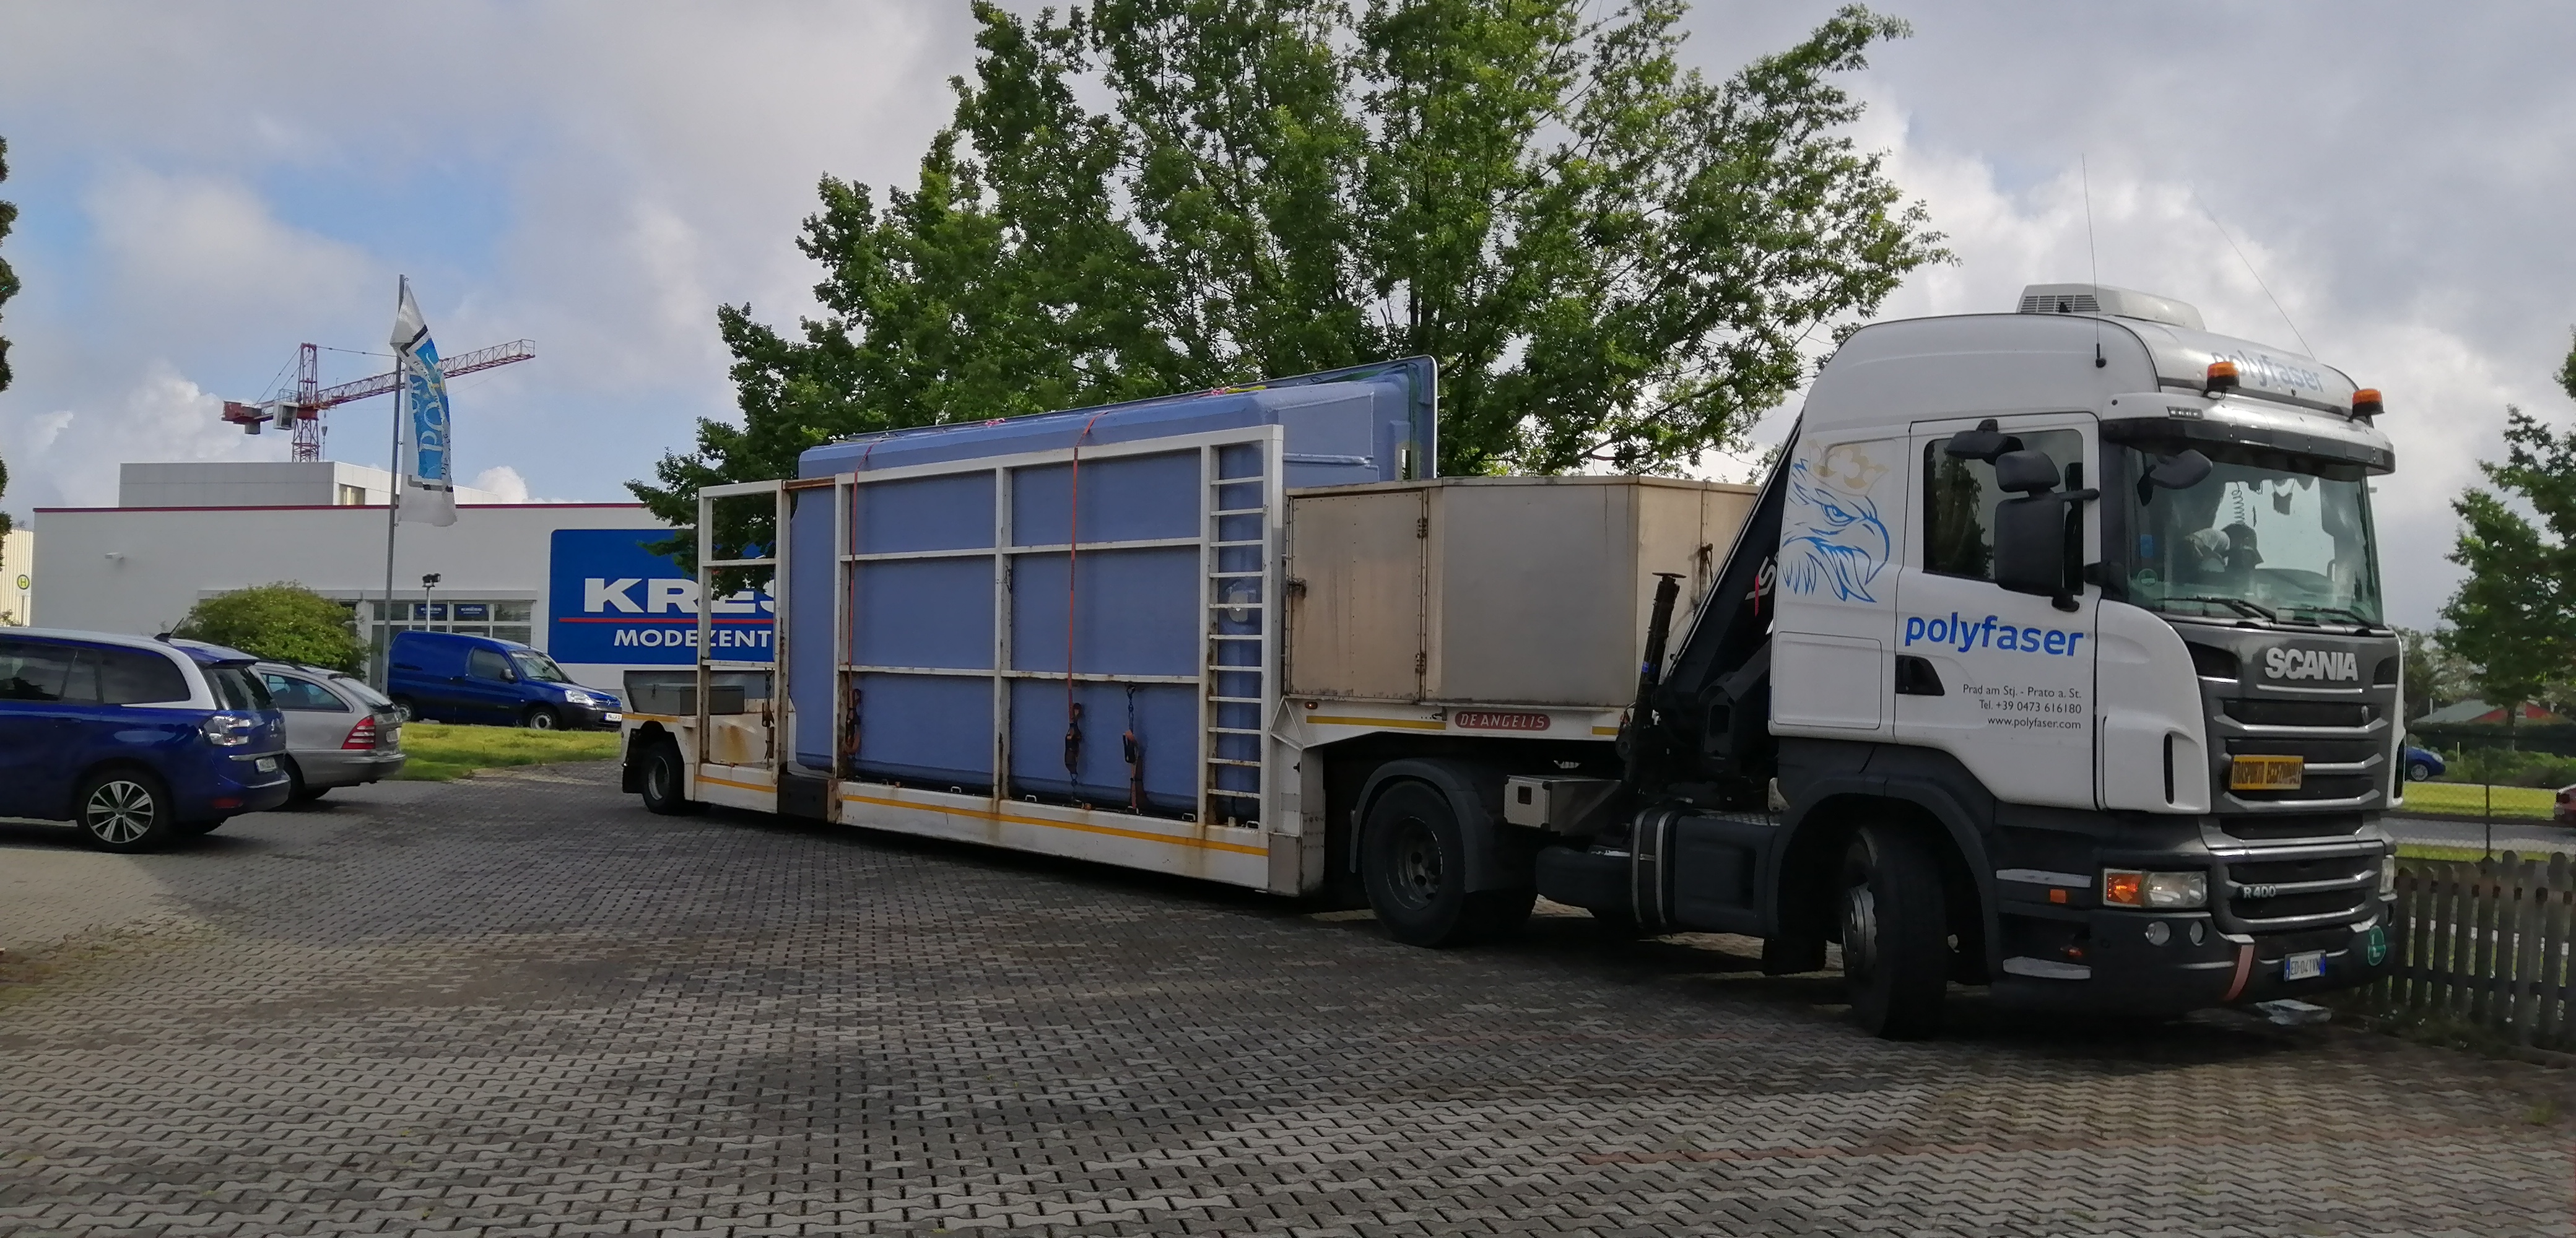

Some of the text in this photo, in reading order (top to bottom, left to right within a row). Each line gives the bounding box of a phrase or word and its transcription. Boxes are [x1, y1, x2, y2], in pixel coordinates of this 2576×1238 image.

[20, 578, 27, 587] H
[1905, 612, 2084, 656] polyfaser
[2265, 647, 2359, 682] SCANIA
[1963, 684, 1983, 695] Prad
[2003, 685, 2018, 698] Stj.
[2027, 686, 2055, 698] Prato
[2069, 688, 2082, 699] St.
[1979, 699, 2082, 714] Tel. +39 0473 616180
[1460, 713, 1545, 728] DE ANGELIS
[1987, 717, 2082, 730] www.polyfaser.com
[2243, 885, 2276, 898] R 400
